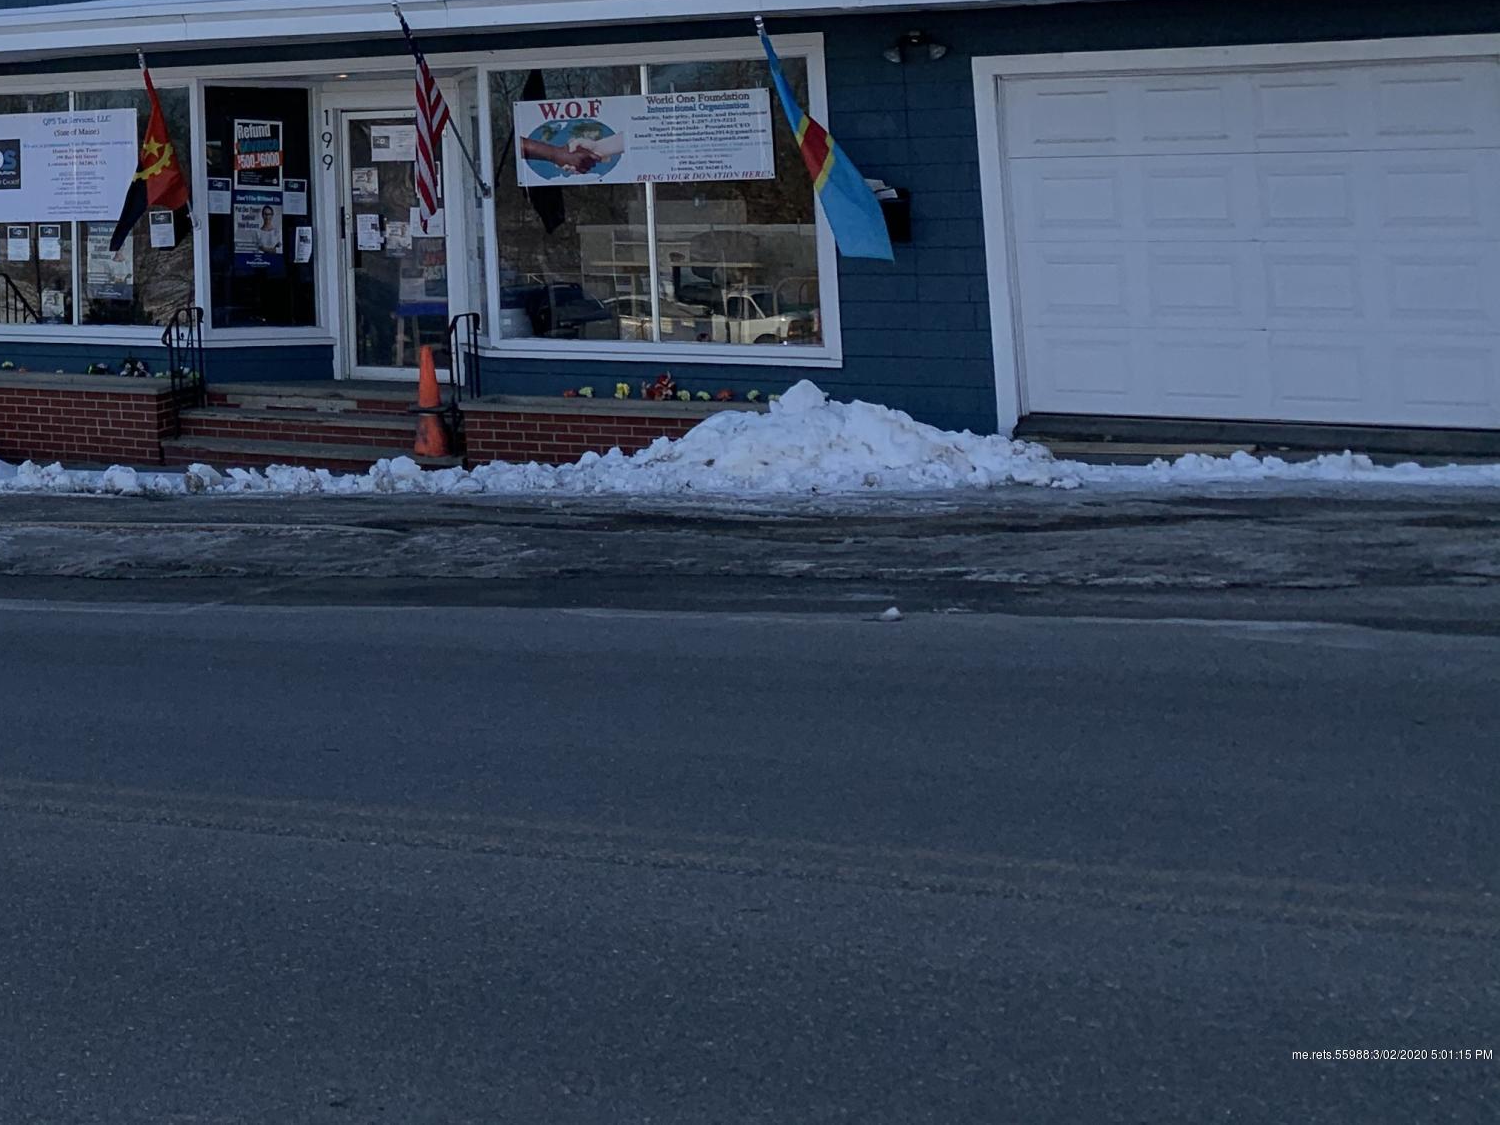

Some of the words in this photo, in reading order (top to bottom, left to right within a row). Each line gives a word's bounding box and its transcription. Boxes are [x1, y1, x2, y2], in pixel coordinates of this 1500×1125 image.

[647, 96, 673, 105] World
[676, 94, 696, 103] One
[698, 92, 750, 102] Foundation
[647, 103, 696, 114] International
[698, 102, 750, 113] Organization
[42, 117, 57, 126] QPS
[97, 115, 112, 123] LLC
[78, 127, 100, 136] Maine)
[237, 123, 271, 139] Refund
[320, 108, 334, 171] 199
[636, 173, 664, 182] BRING
[665, 173, 691, 181] YOUR
[692, 171, 740, 180] DONATION
